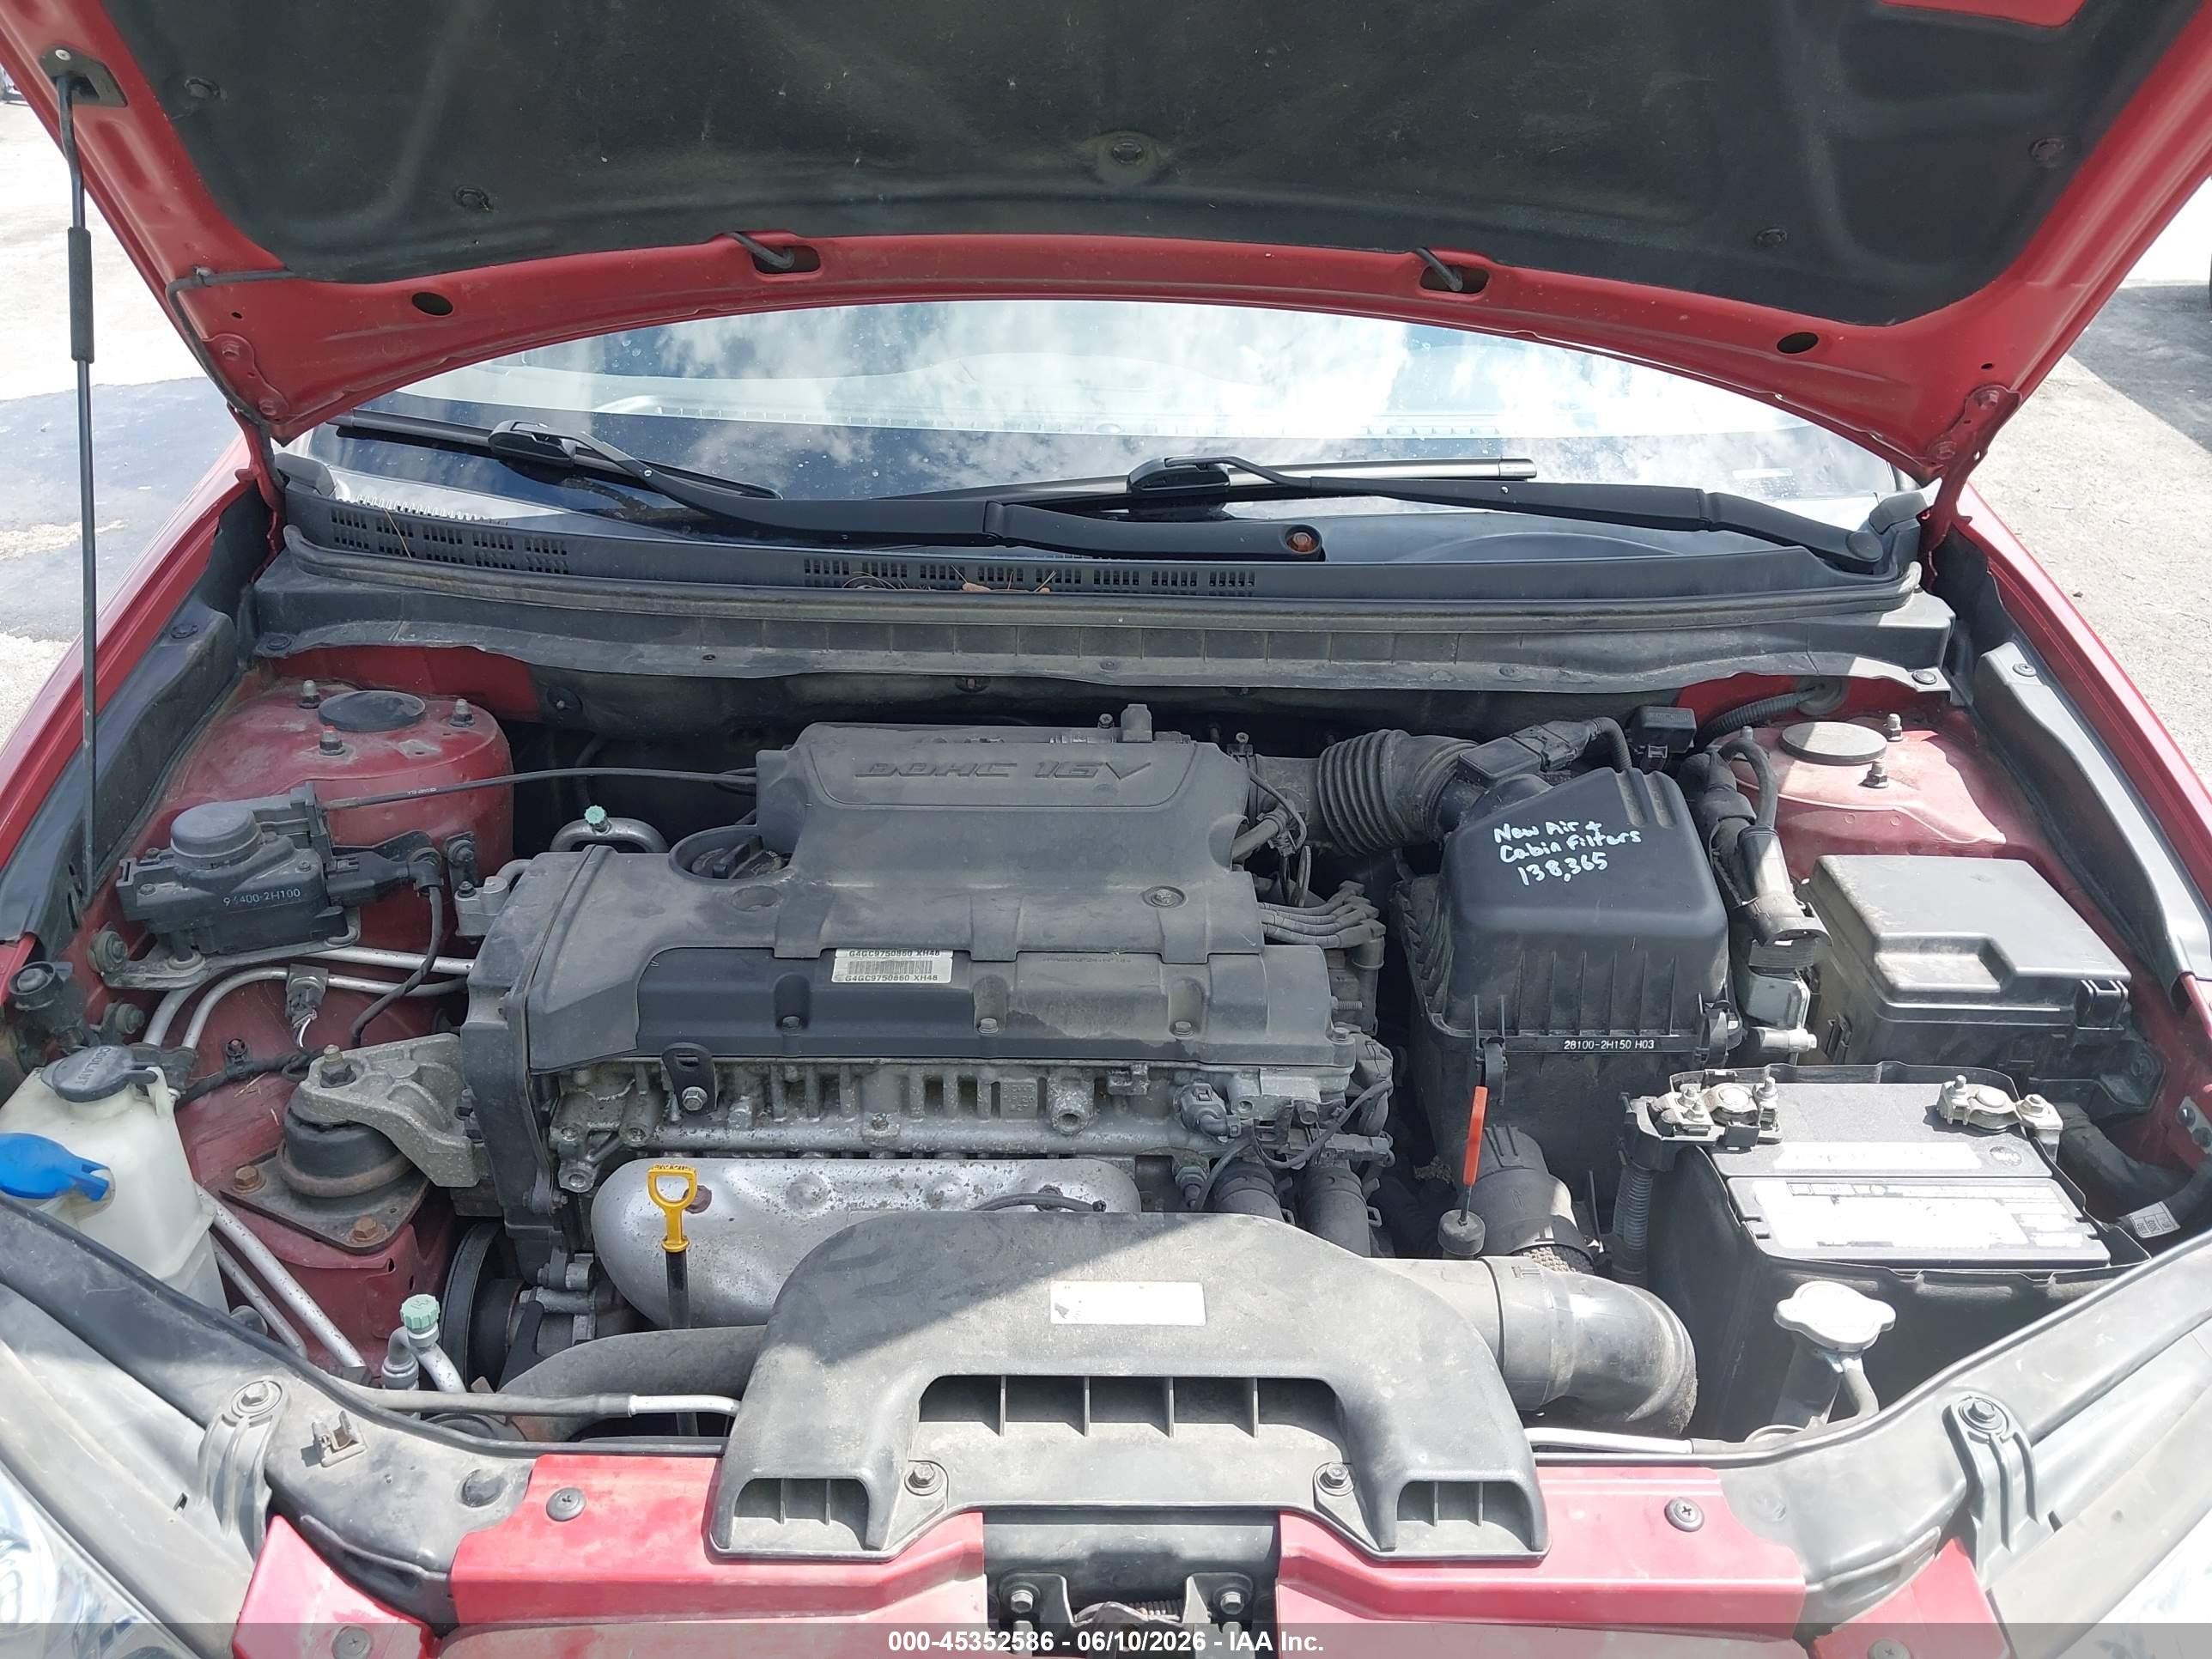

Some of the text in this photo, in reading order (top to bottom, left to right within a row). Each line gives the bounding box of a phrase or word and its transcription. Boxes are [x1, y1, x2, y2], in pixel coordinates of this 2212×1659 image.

[854, 761, 1152, 781] DOHC 16V
[1493, 823, 1540, 844] New
[1545, 820, 1580, 836] Air
[1500, 830, 1642, 863] Cabin Filters
[1517, 851, 1608, 886] 138,365
[1564, 1039, 1655, 1050] 28100-2H150 H03
[75, 1046, 112, 1086] COOLANT
